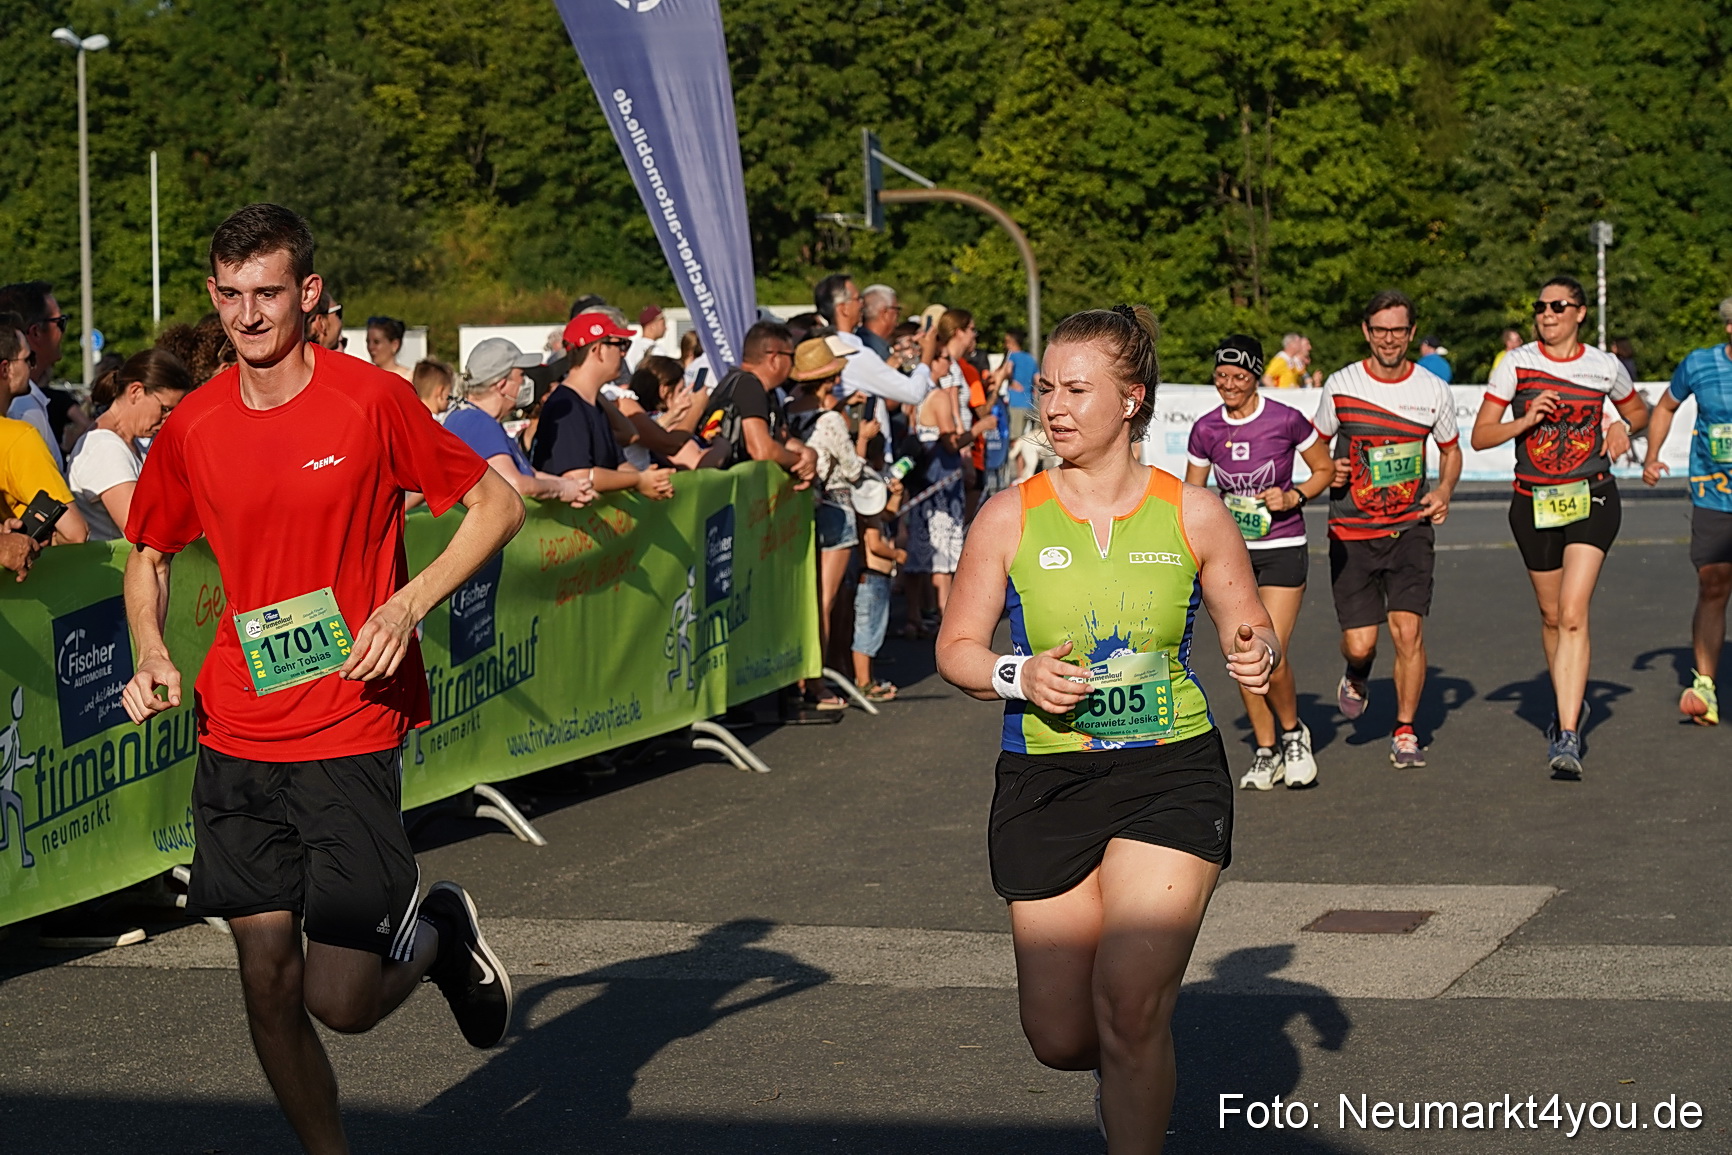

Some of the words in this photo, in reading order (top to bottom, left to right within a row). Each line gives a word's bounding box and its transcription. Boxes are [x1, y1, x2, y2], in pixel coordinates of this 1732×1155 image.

[313, 454, 335, 471] DEHN
[1385, 457, 1411, 473] 137
[1234, 510, 1261, 528] 548
[1549, 496, 1577, 513] 154
[1129, 551, 1183, 566] BOCK
[196, 584, 225, 628] Ge
[260, 621, 330, 664] 1701
[329, 620, 351, 656] 2022
[68, 642, 116, 677] Fischer
[249, 649, 267, 679] RUN
[273, 661, 297, 675] Gehr
[297, 651, 332, 667] Tobias
[74, 664, 113, 689] AUTOMOBILE
[1088, 684, 1146, 717] 605
[1156, 686, 1169, 726] 2022
[429, 711, 481, 754] neumarkt
[1075, 718, 1127, 729] Morawietz
[1128, 715, 1160, 725] Jesika
[42, 799, 111, 855] neumarkt
[152, 806, 196, 853] www.f
